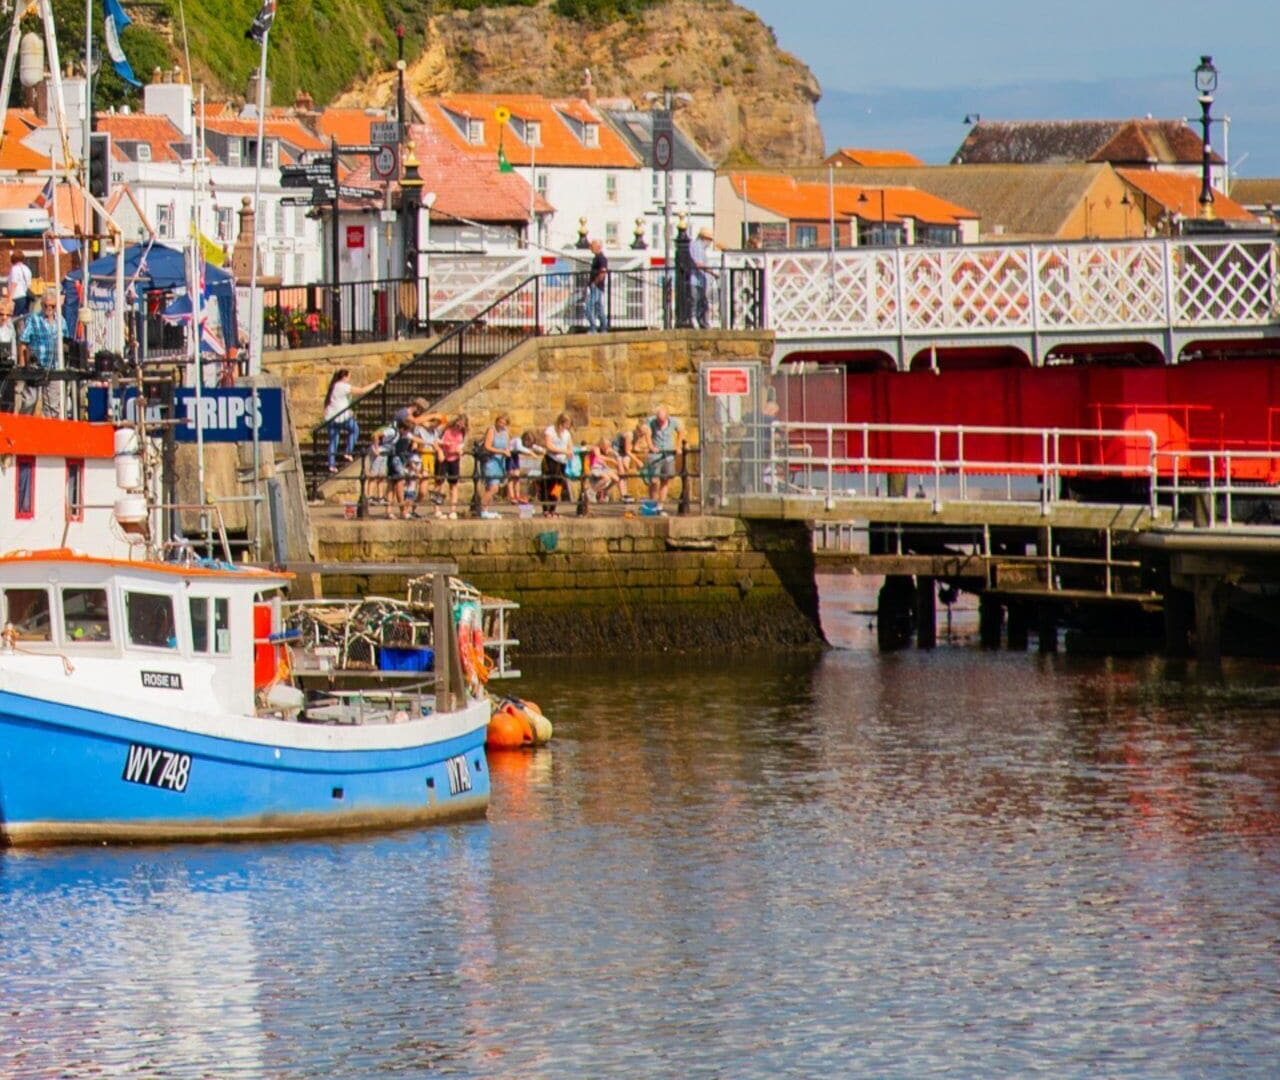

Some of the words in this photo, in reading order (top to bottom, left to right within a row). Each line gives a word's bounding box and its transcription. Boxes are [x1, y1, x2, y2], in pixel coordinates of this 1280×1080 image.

[184, 397, 263, 430] TRIPS
[143, 672, 170, 687] ROSIE
[170, 675, 180, 688] M
[126, 744, 162, 784] WY
[157, 750, 190, 792] 748
